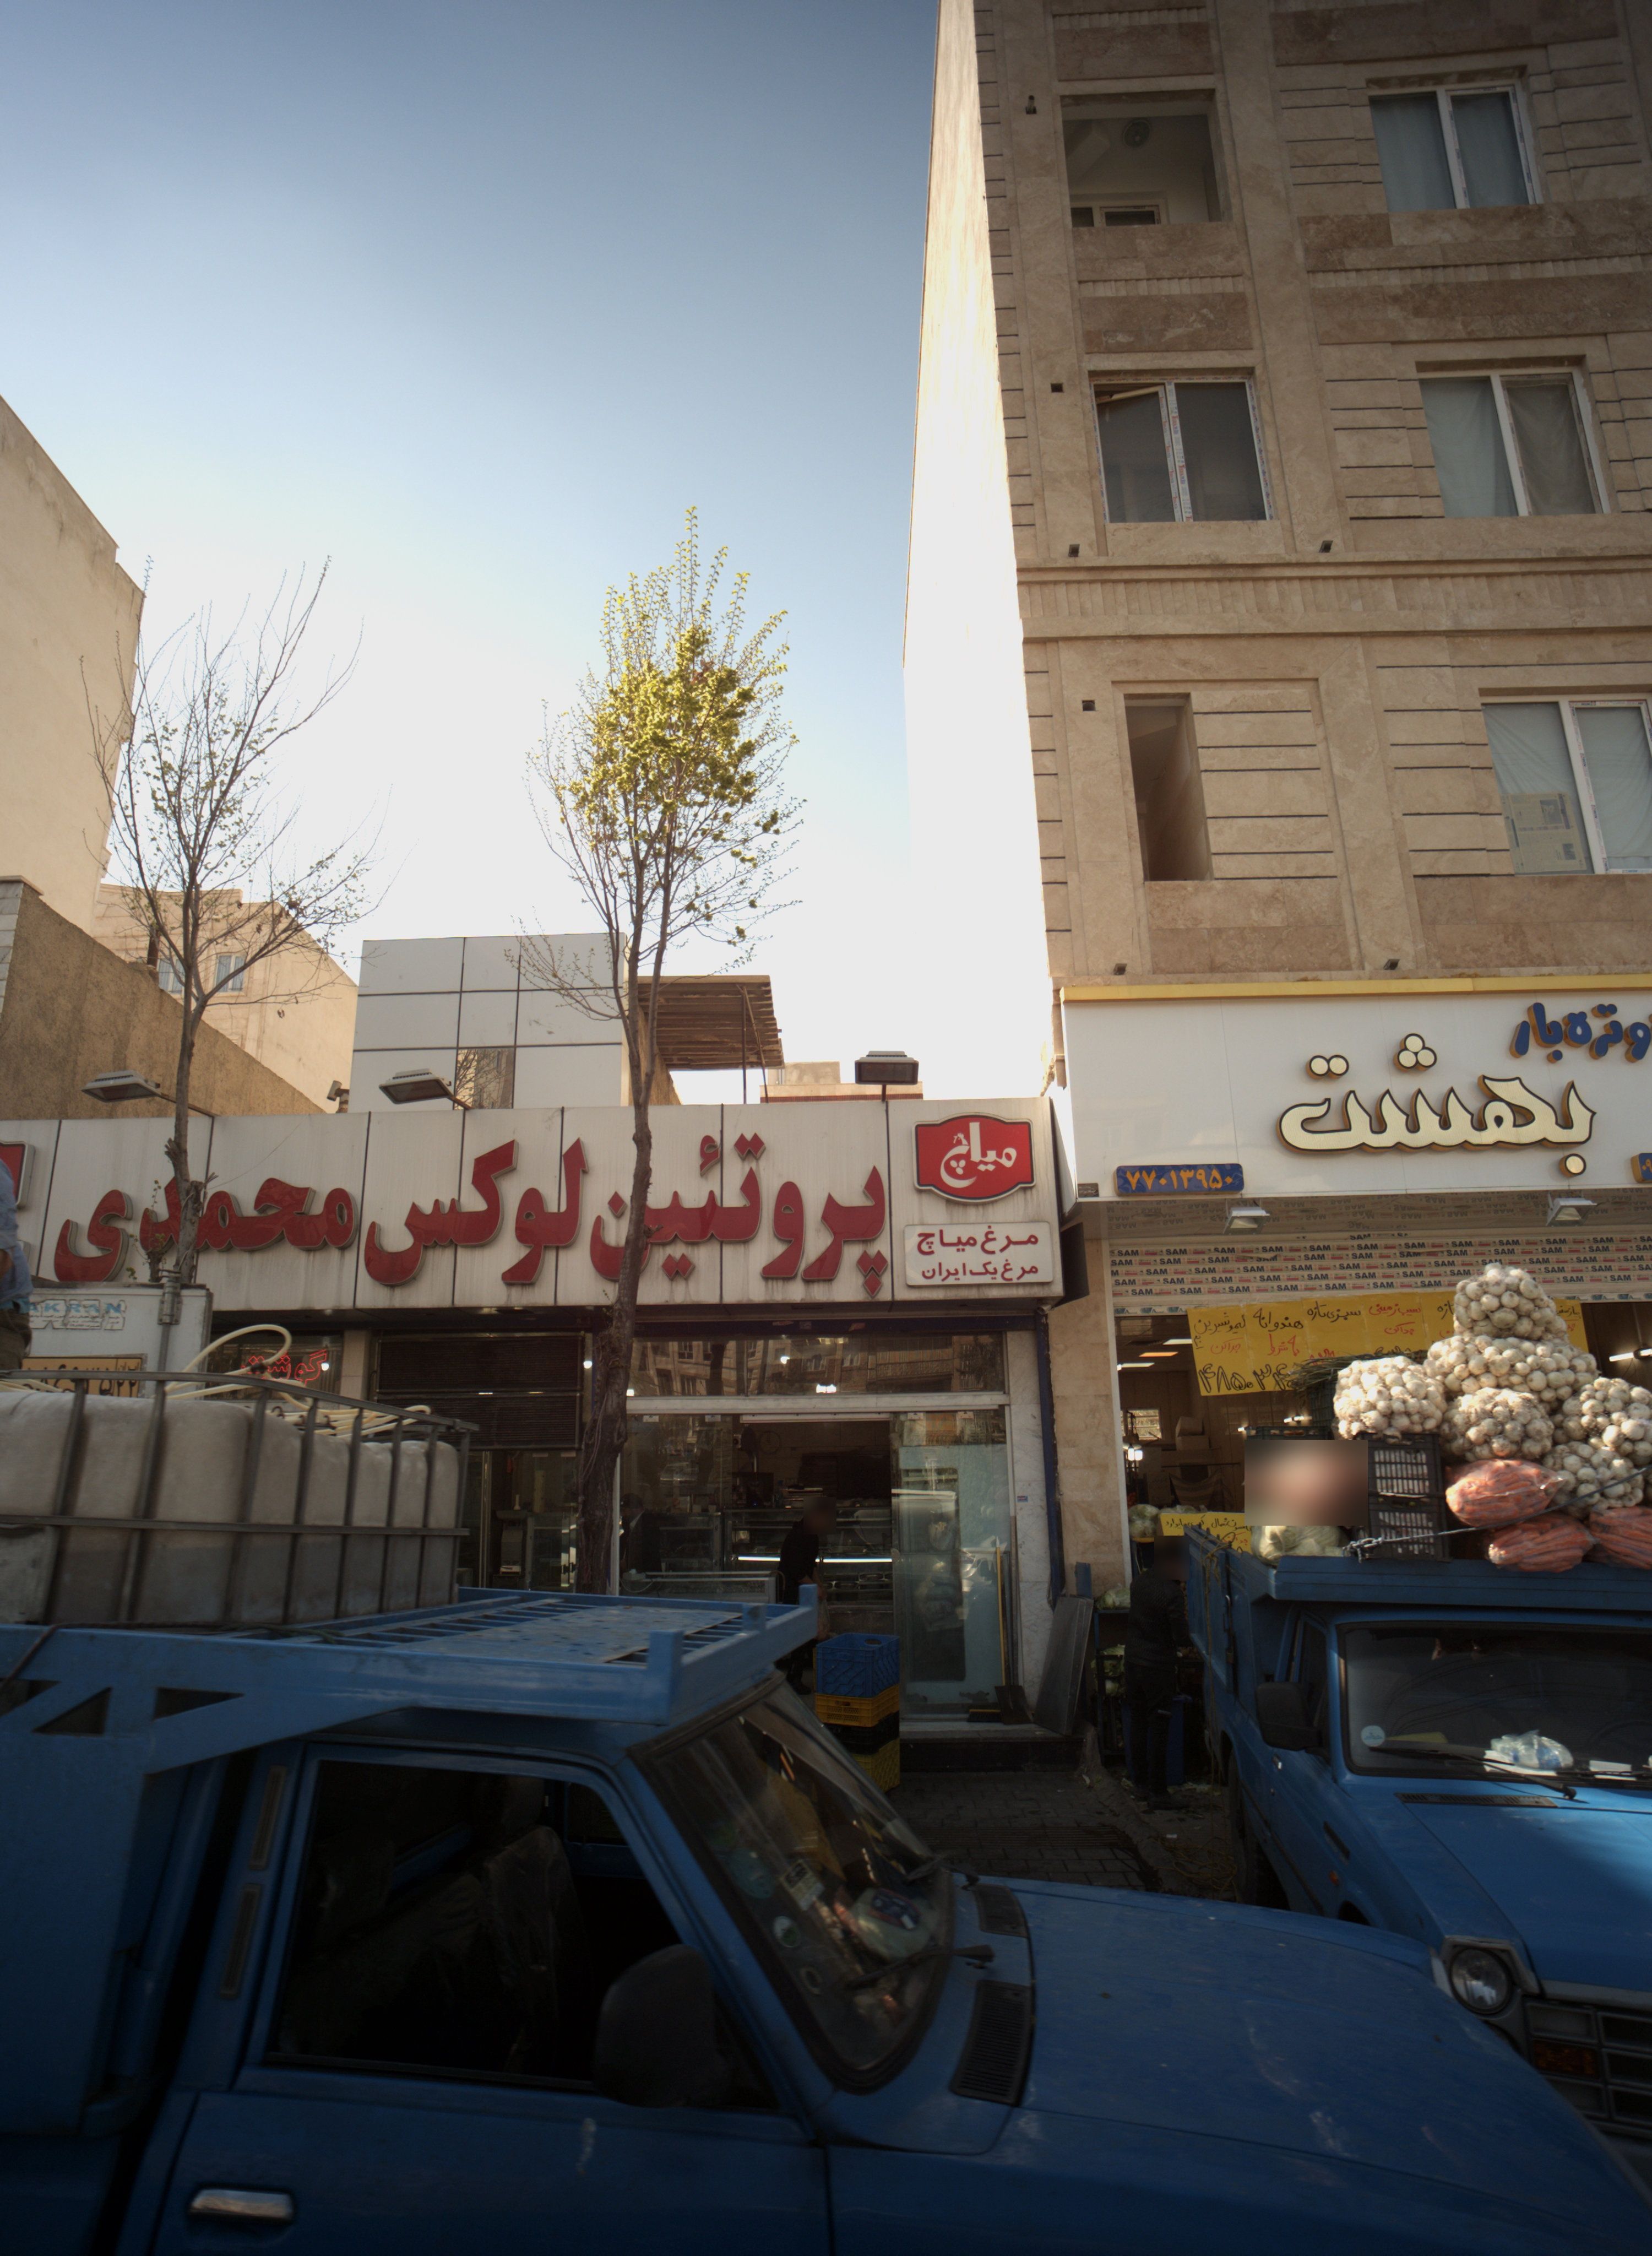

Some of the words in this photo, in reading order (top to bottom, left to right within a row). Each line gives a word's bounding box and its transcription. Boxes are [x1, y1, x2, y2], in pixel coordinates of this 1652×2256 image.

[1276, 1033, 1596, 1178] بهشت
[940, 1122, 1017, 1188] میاچ
[1126, 1168, 1233, 1191] ۷۷۰۱۳۹۵۰
[364, 1137, 589, 1287] لوکس
[590, 1132, 888, 1298] پروتئین
[54, 1176, 360, 1282] محمدی
[917, 1229, 977, 1255] میاچ
[980, 1225, 1039, 1255] مرغ
[921, 1262, 966, 1282] ایران
[969, 1262, 998, 1280] یک
[1001, 1259, 1039, 1281] مرغ
[1327, 1308, 1361, 1323] سبزی
[1437, 1300, 1454, 1320] ازه
